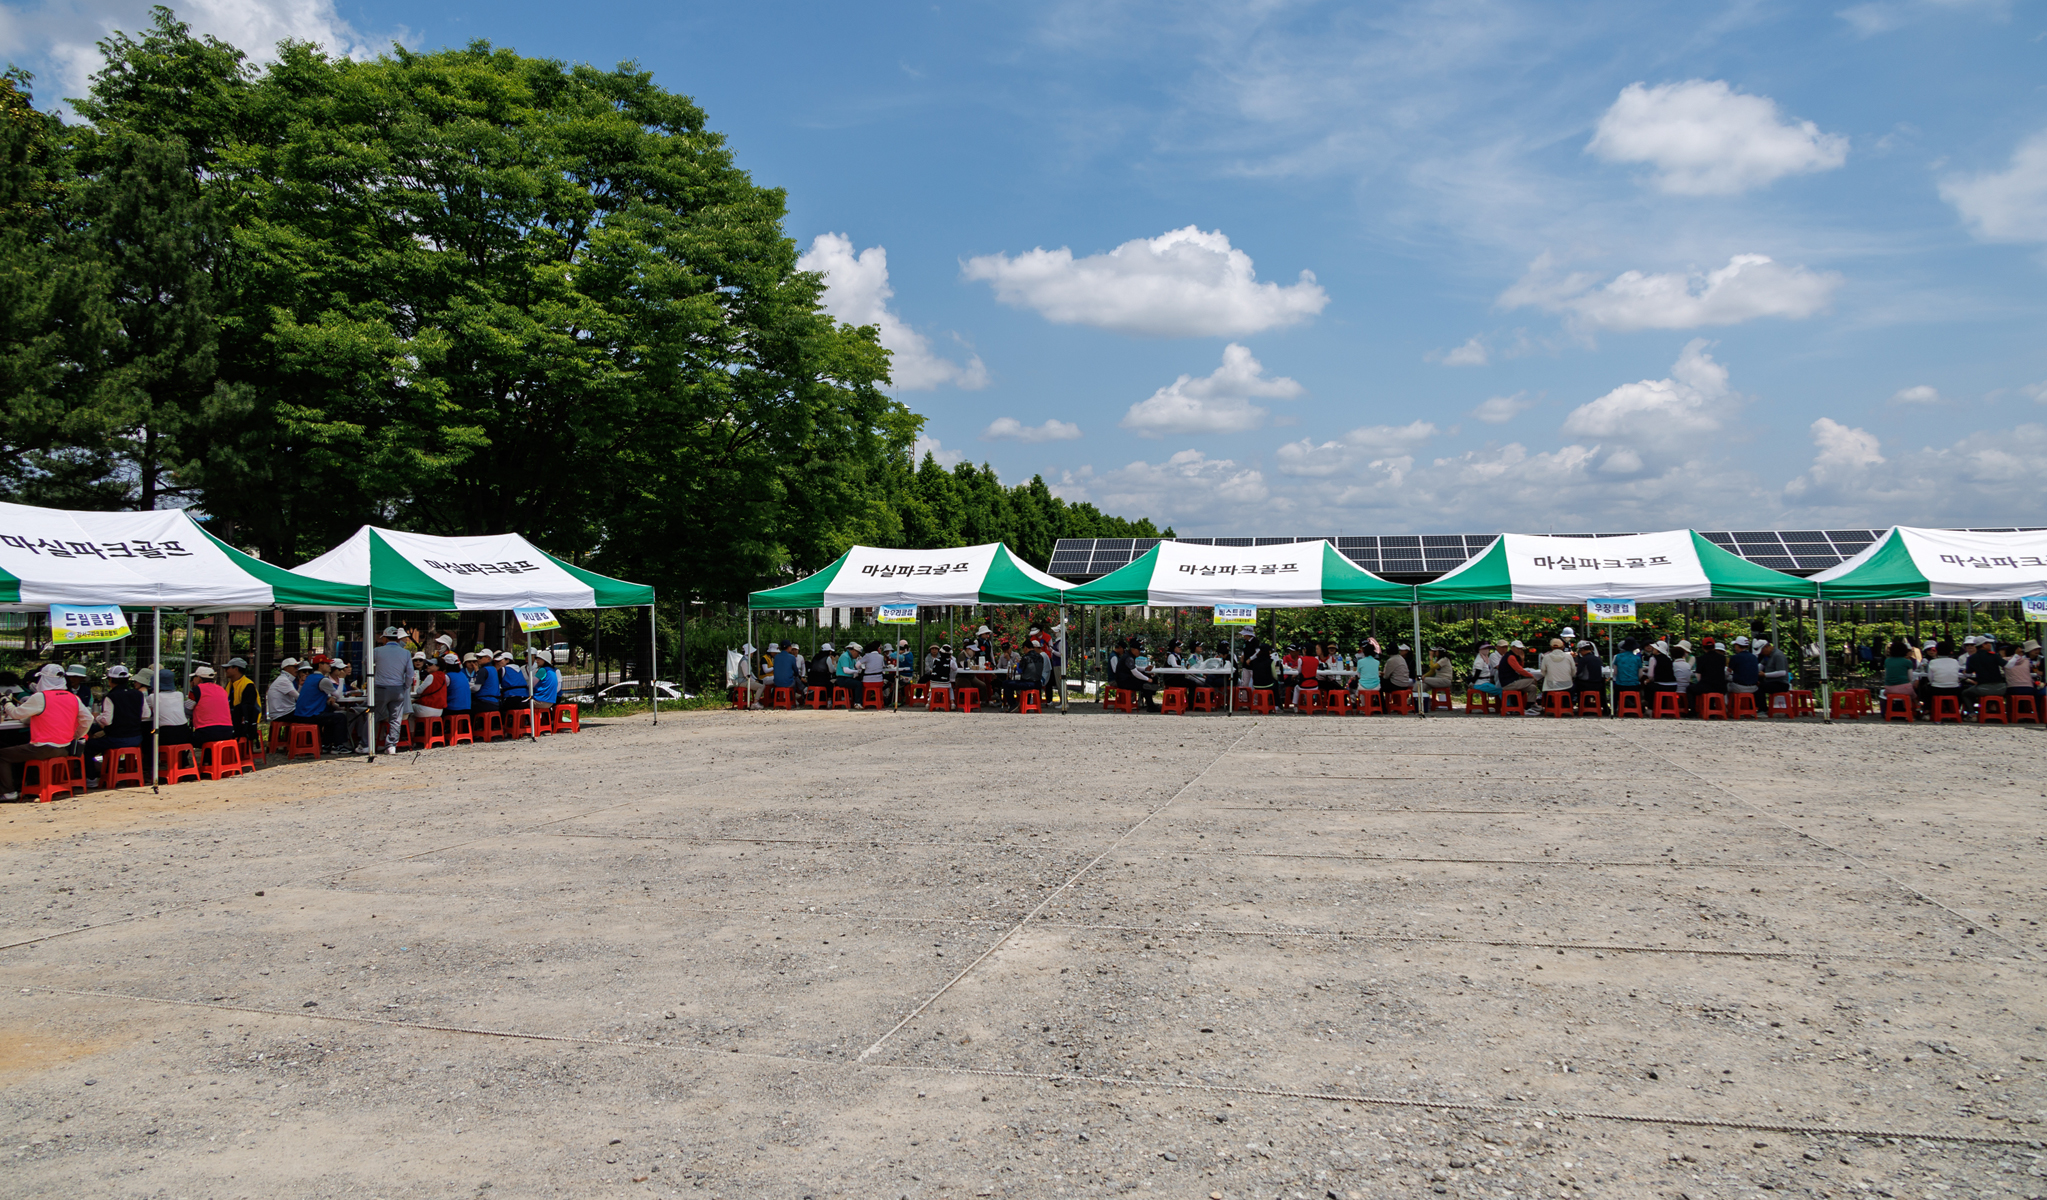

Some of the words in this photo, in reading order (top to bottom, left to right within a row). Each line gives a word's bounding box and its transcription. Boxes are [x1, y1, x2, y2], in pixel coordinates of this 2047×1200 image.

[0, 534, 194, 560] 마실파크골프
[423, 559, 540, 576] 마실파크골프
[1533, 556, 1672, 571] 마실파크골프
[1940, 554, 2047, 569] 마실파크
[861, 562, 969, 577] 마실파크골프
[1179, 563, 1299, 577] 마실파크골프
[1218, 608, 1252, 617] 베스트클럽
[1595, 603, 1629, 613] 우장클럽
[2027, 601, 2047, 611] 나이
[65, 612, 115, 626] 드림클럽
